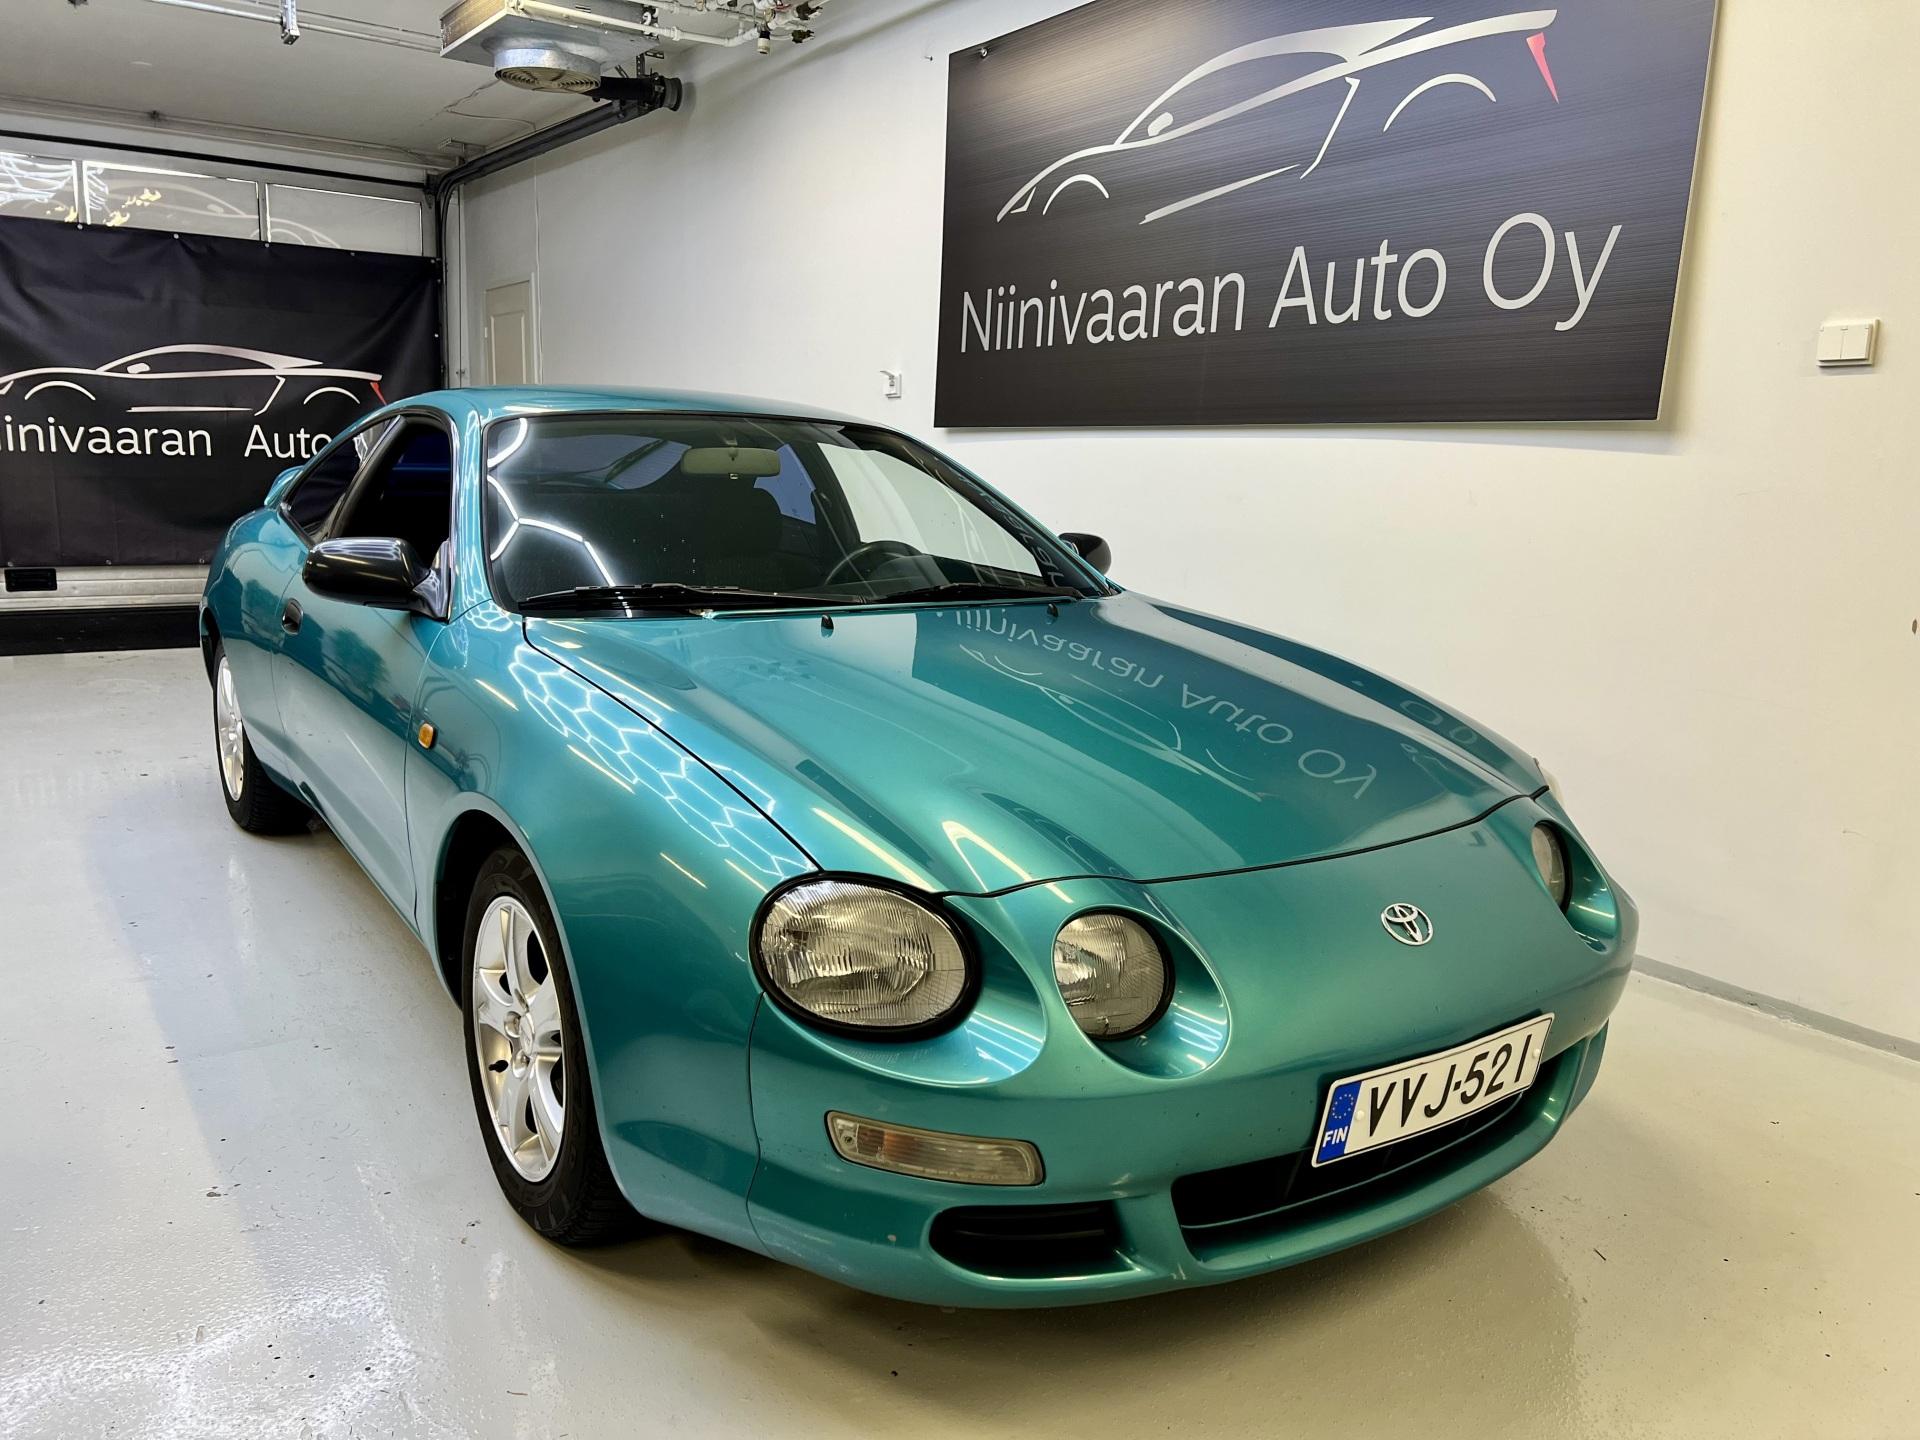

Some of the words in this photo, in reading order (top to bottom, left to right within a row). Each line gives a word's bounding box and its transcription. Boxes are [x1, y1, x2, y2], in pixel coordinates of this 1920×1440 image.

[961, 272, 1246, 353] Niinivaaran
[1269, 238, 1447, 328] Auto
[1483, 212, 1623, 331] Oy
[0, 414, 212, 457] inivaaran
[1369, 1033, 1533, 1137] VVJ-521
[1322, 1126, 1349, 1148] FIN
